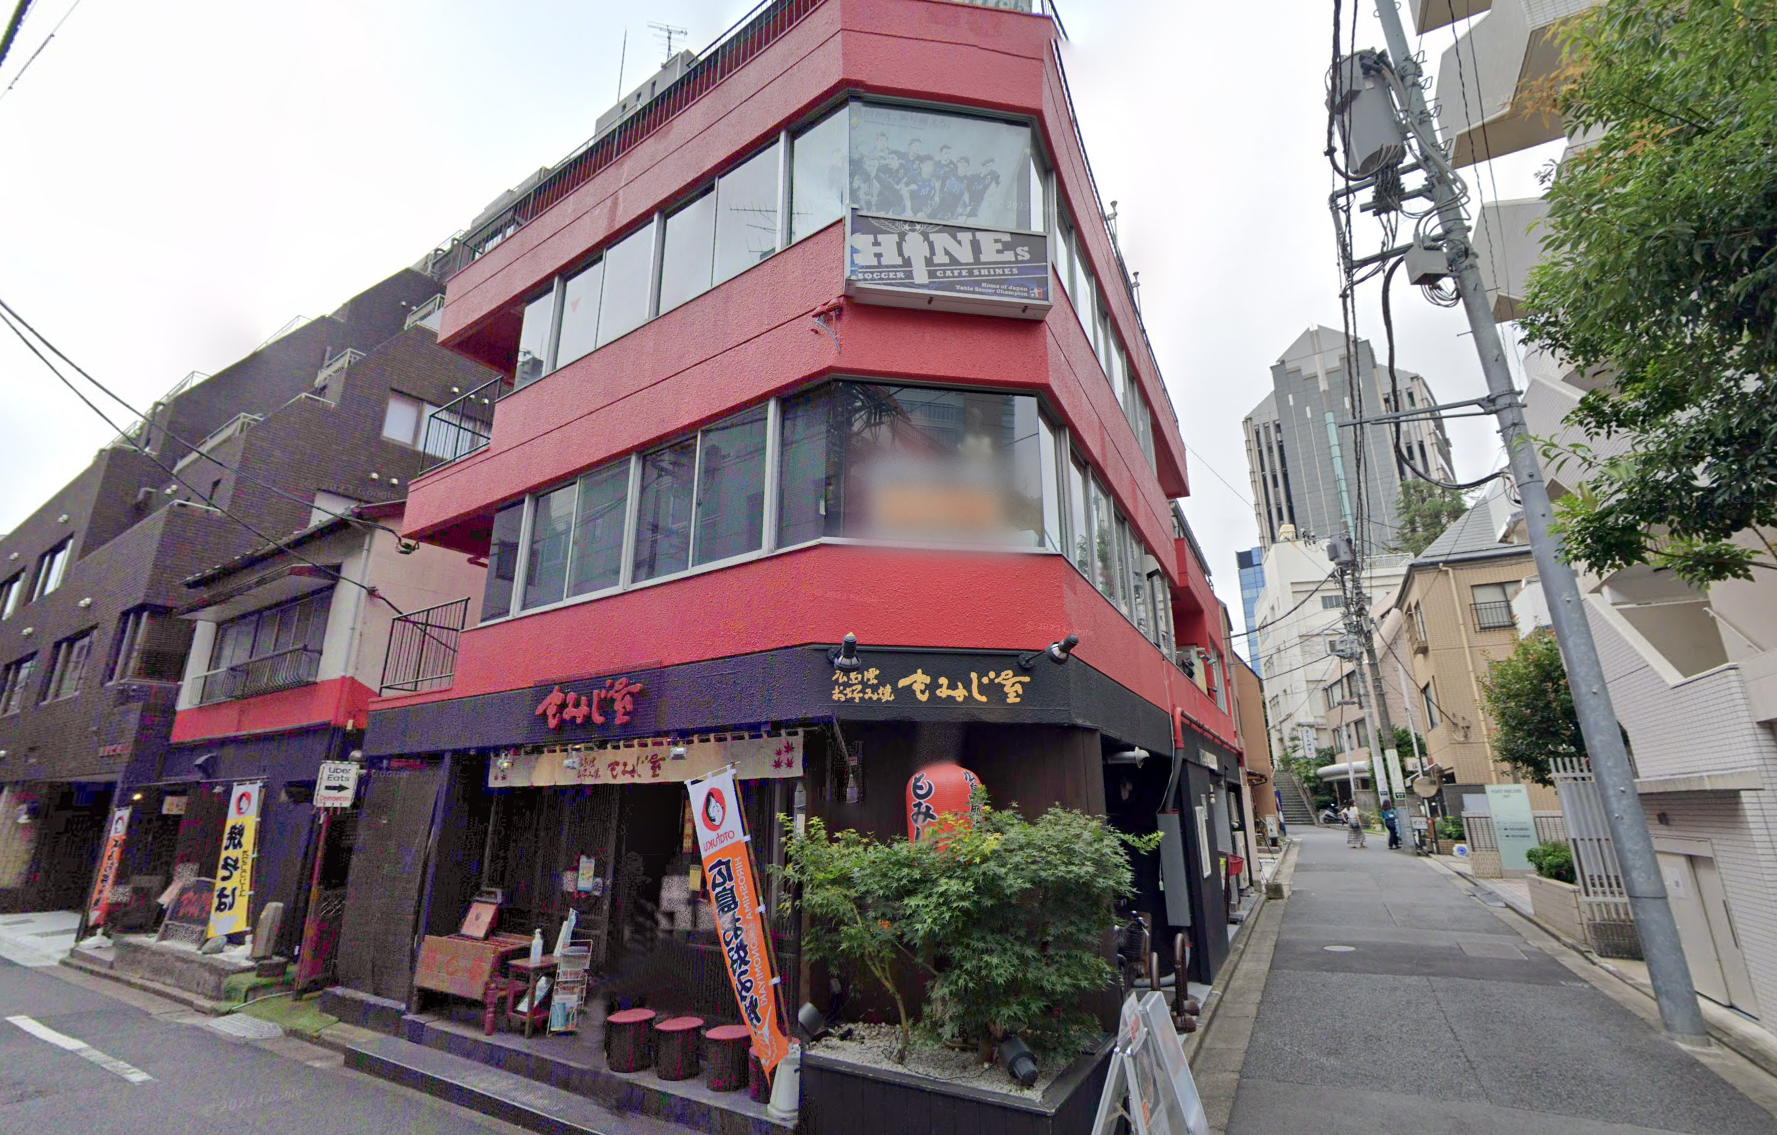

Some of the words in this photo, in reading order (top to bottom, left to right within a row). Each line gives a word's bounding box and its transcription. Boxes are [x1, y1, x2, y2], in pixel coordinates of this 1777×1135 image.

[857, 271, 905, 280] SOCCER
[936, 269, 969, 277] CAFE
[973, 267, 1019, 276] SHINES
[996, 289, 1028, 297] Champion
[898, 668, 1031, 703] もみじ屋
[831, 684, 895, 703] お好み焼
[536, 677, 643, 733] もみじ屋
[329, 766, 352, 774] Uber
[327, 774, 350, 782] Eats
